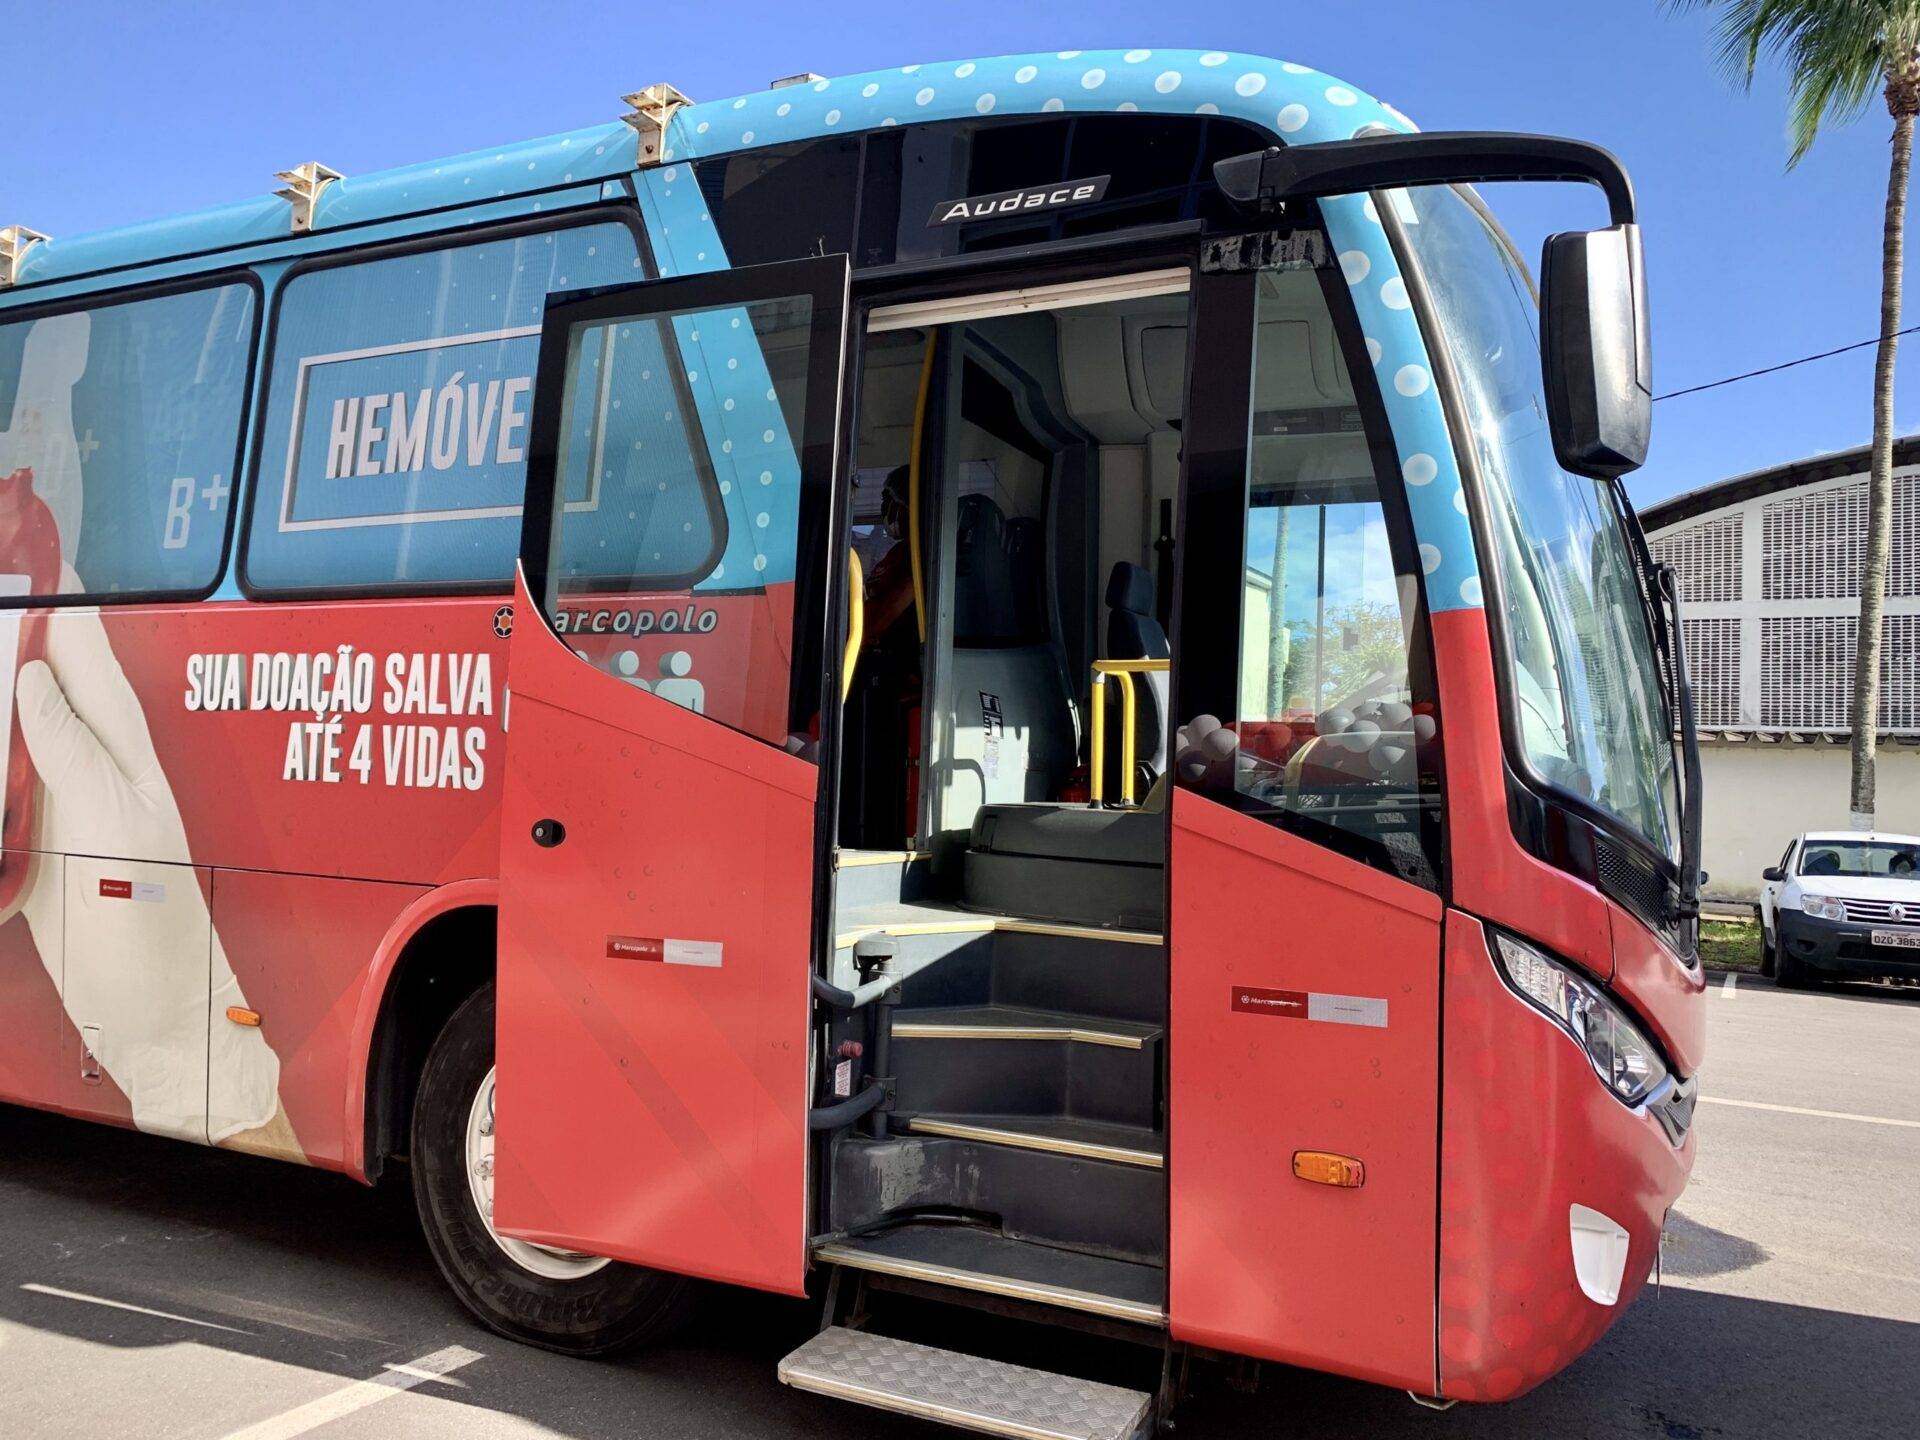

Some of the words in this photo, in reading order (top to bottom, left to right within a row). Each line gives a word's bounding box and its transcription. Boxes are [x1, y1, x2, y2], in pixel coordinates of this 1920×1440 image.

[941, 184, 1096, 222] Audace
[185, 652, 245, 711] SUA
[250, 644, 374, 721] DOAÇÃO
[383, 652, 493, 716] SALVA
[283, 716, 342, 782] ATÉ
[349, 727, 372, 784] 4
[383, 725, 486, 791] VIDAS
